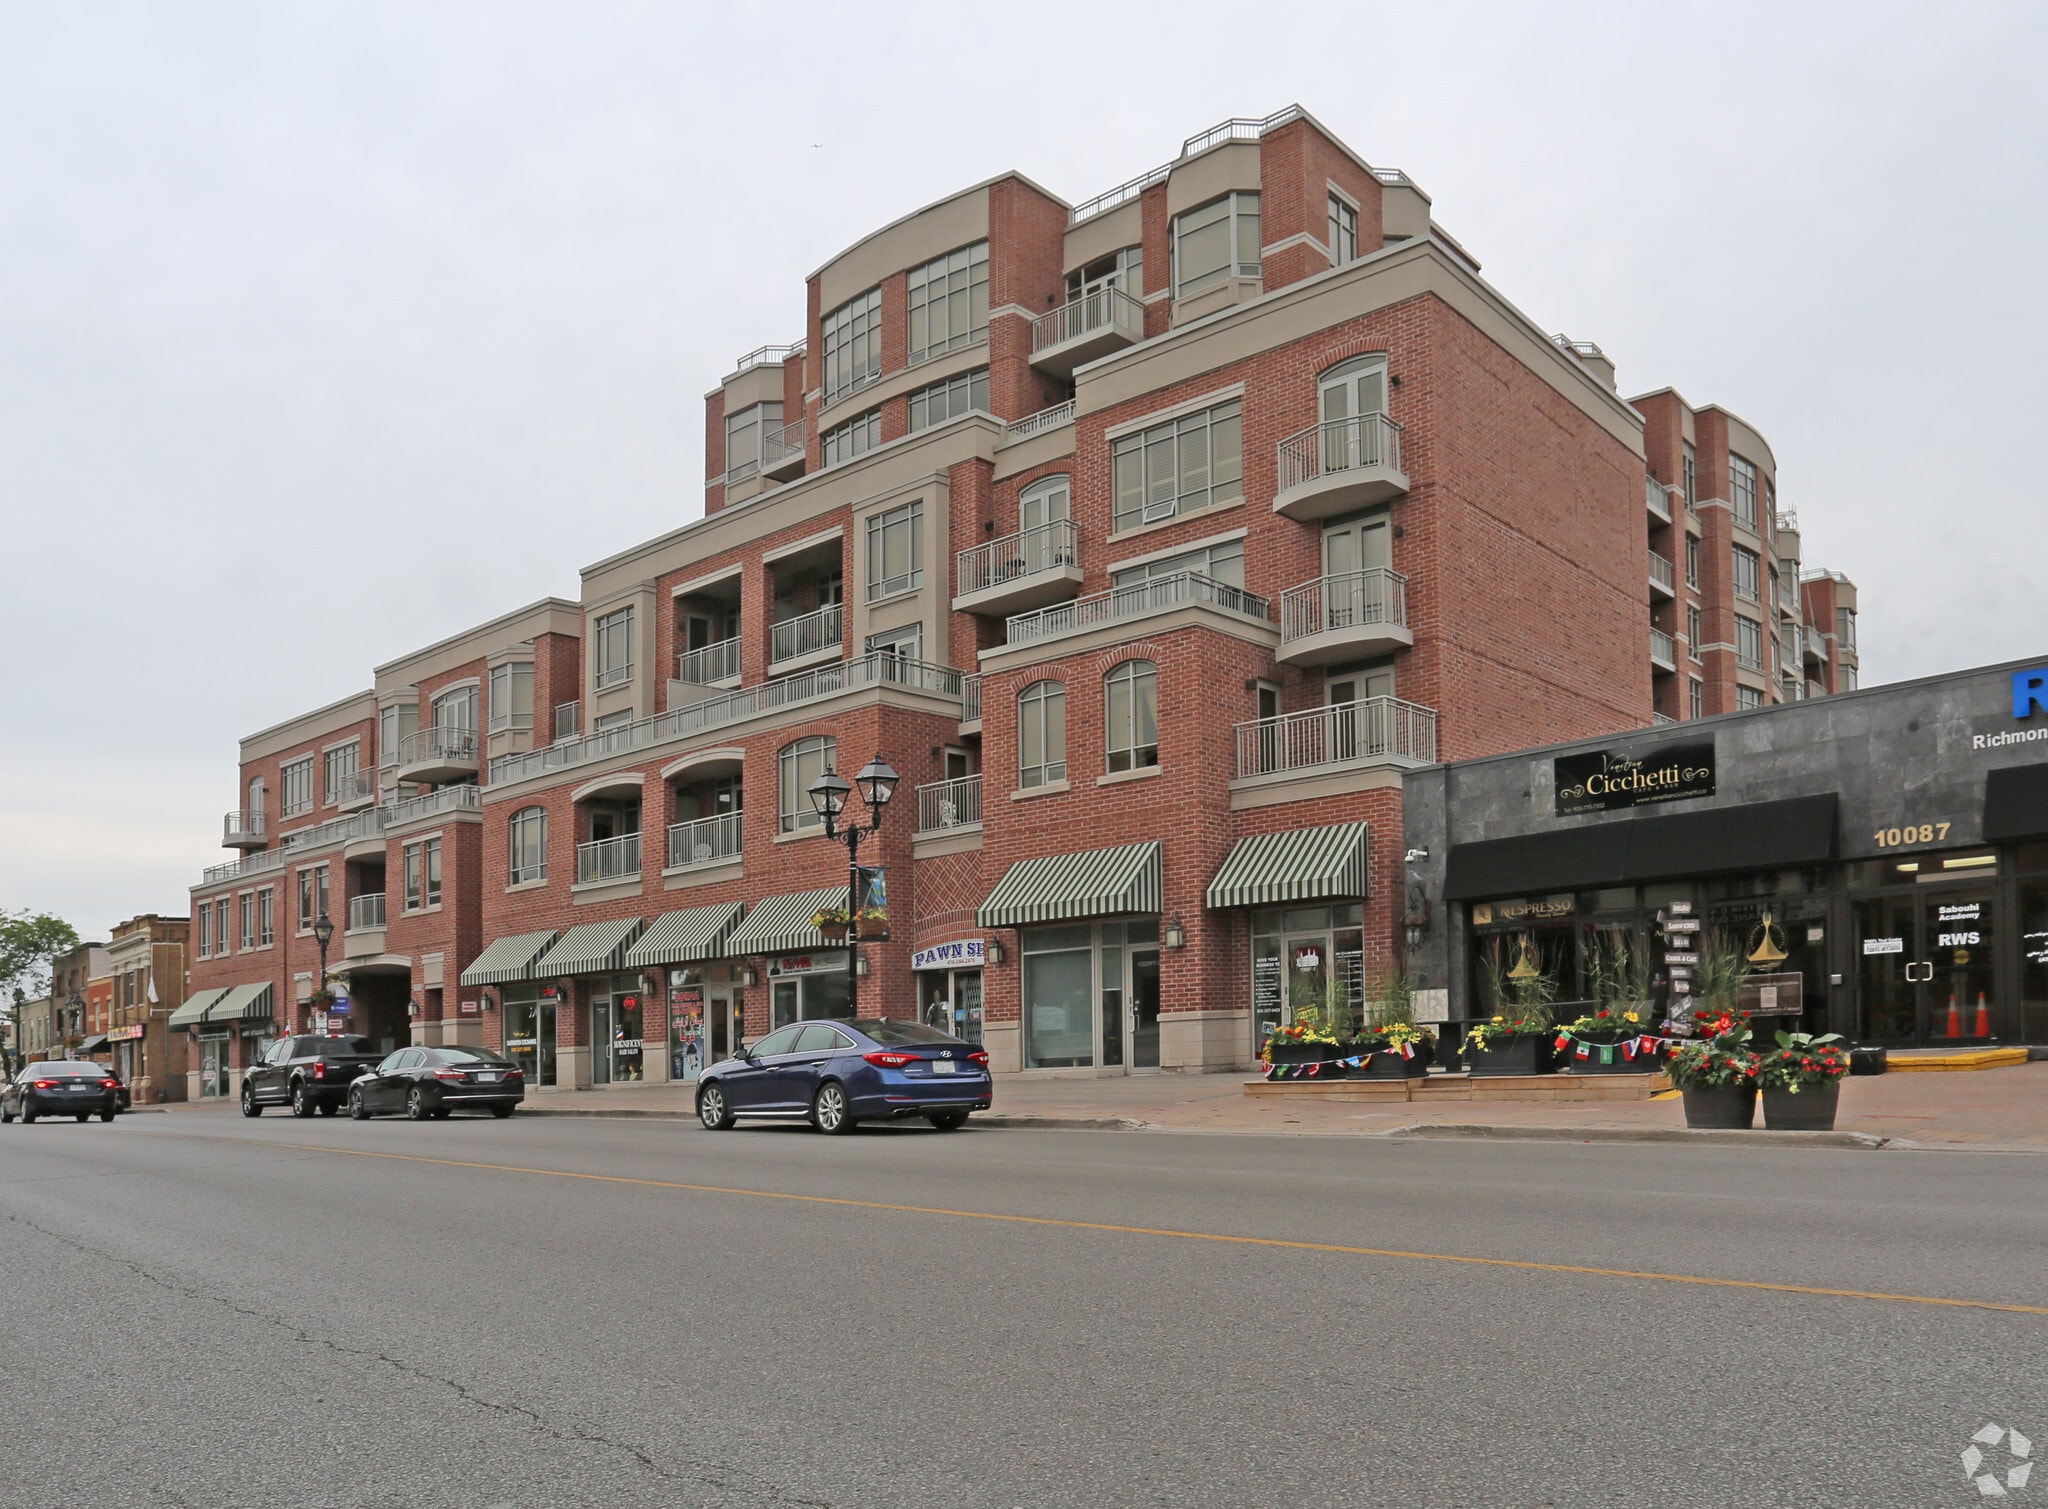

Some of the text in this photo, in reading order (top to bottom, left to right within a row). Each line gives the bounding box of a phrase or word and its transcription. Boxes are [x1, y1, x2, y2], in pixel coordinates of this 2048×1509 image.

[1973, 728, 2048, 749] Richmon
[1586, 765, 1680, 795] Cicchetti
[1874, 822, 1951, 847] 10087
[1500, 901, 1572, 919] NESPRESSO
[1938, 903, 1980, 914] Sabouhi
[1938, 912, 1980, 921] Academy
[1938, 932, 1980, 946] RWS
[783, 956, 812, 970] RE/MAX
[914, 943, 963, 968] PAWN
